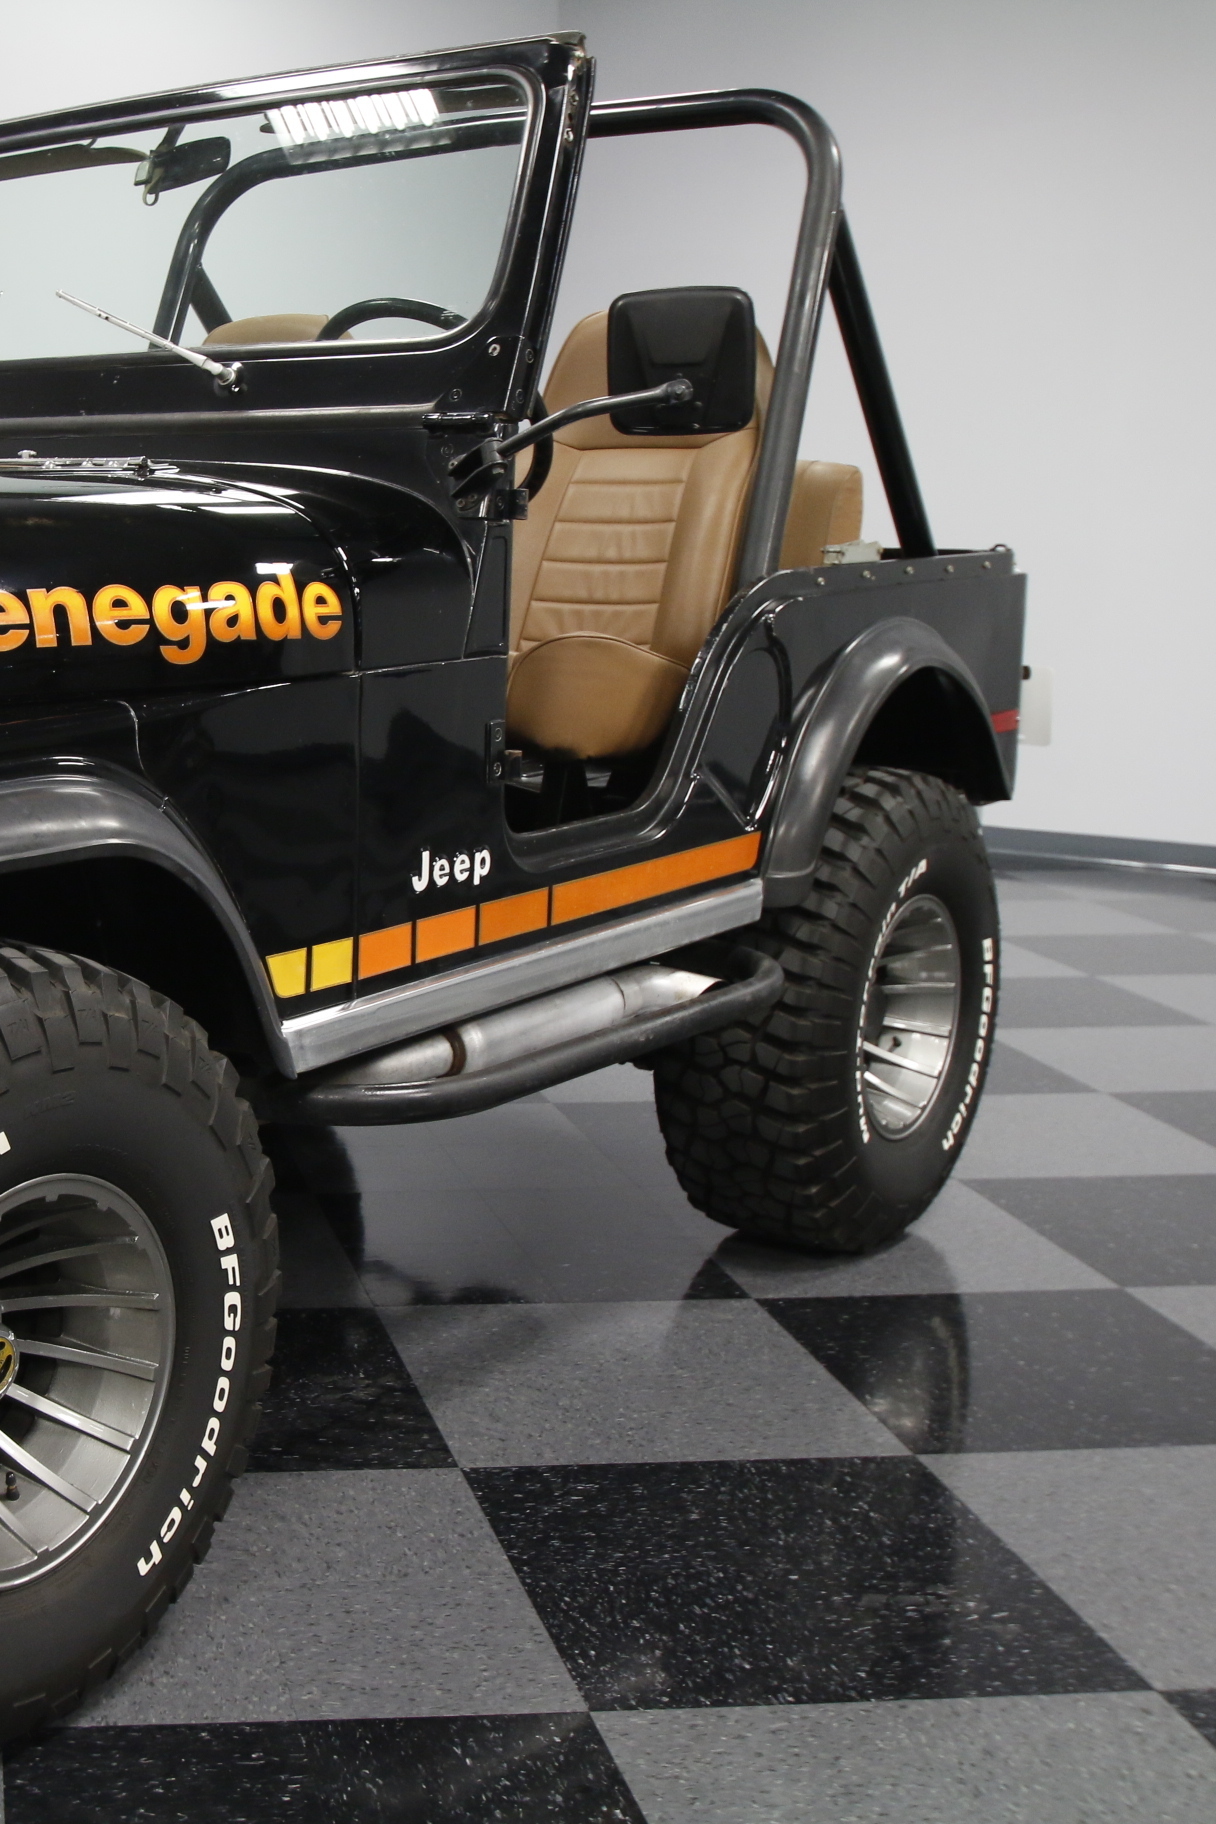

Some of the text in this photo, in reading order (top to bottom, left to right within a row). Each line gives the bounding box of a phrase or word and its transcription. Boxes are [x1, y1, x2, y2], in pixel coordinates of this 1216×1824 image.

[411, 848, 492, 893] Jeep
[941, 937, 994, 1151] BFGoodrich
[137, 1212, 242, 1577] BFGoodrich
